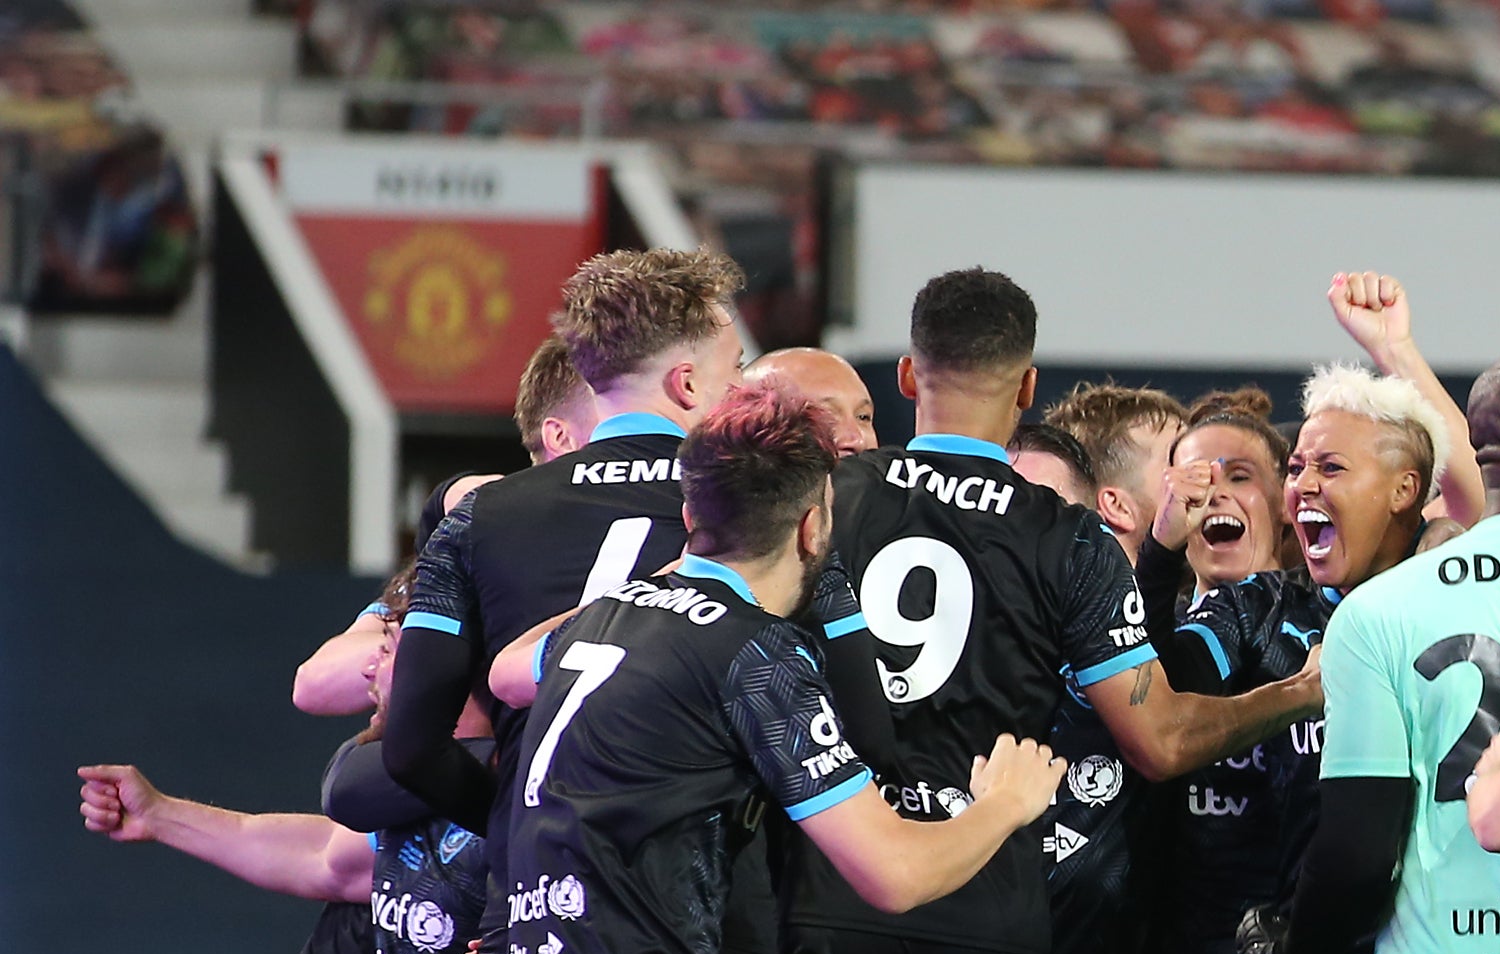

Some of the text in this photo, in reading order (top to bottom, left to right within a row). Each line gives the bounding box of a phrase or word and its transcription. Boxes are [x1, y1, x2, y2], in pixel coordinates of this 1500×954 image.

[886, 458, 1014, 516] LYNCH
[860, 537, 974, 703] 9
[524, 641, 627, 808] 7
[1188, 784, 1248, 815] itv
[1043, 828, 1083, 857] stv
